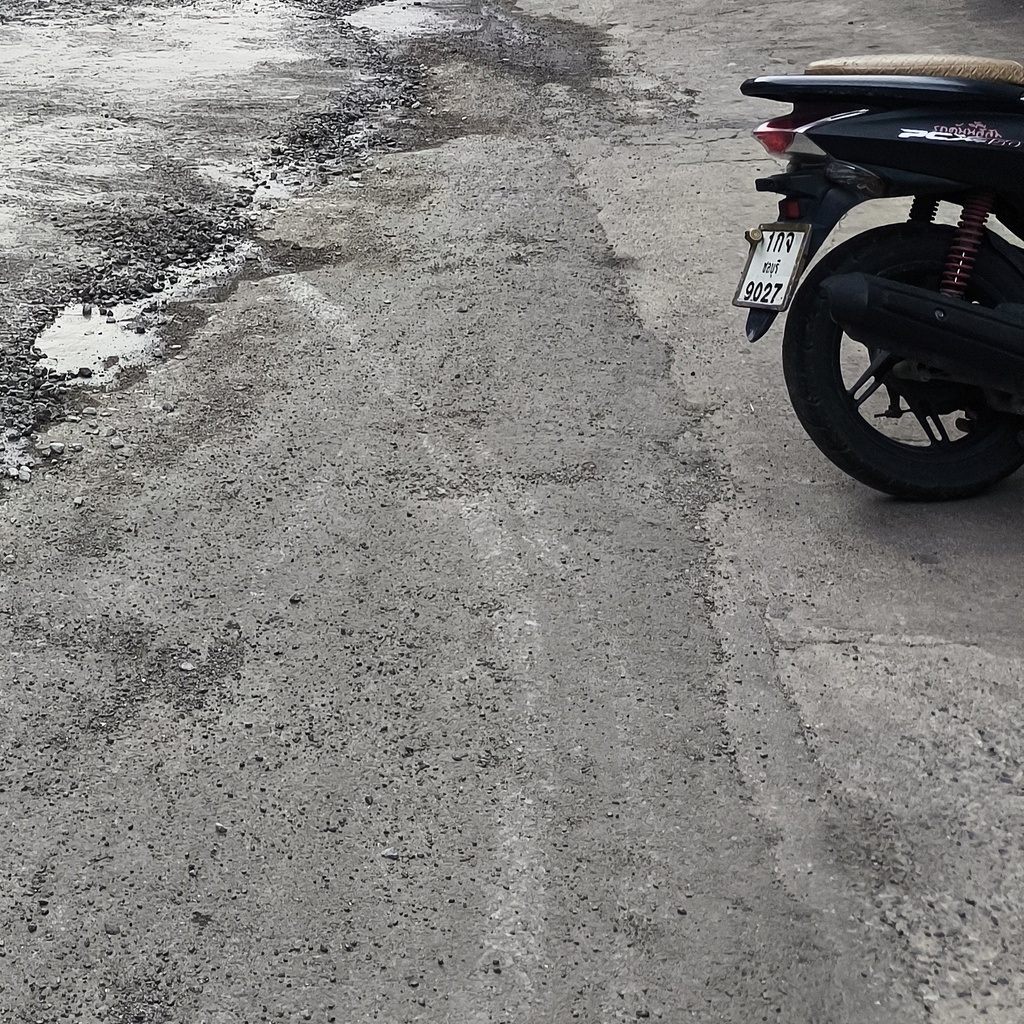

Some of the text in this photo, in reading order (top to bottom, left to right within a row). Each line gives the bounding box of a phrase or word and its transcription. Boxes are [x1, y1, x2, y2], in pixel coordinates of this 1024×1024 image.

[766, 231, 795, 253] 1กจ
[762, 259, 781, 278] ชลบุรี
[744, 280, 783, 304] 9027
